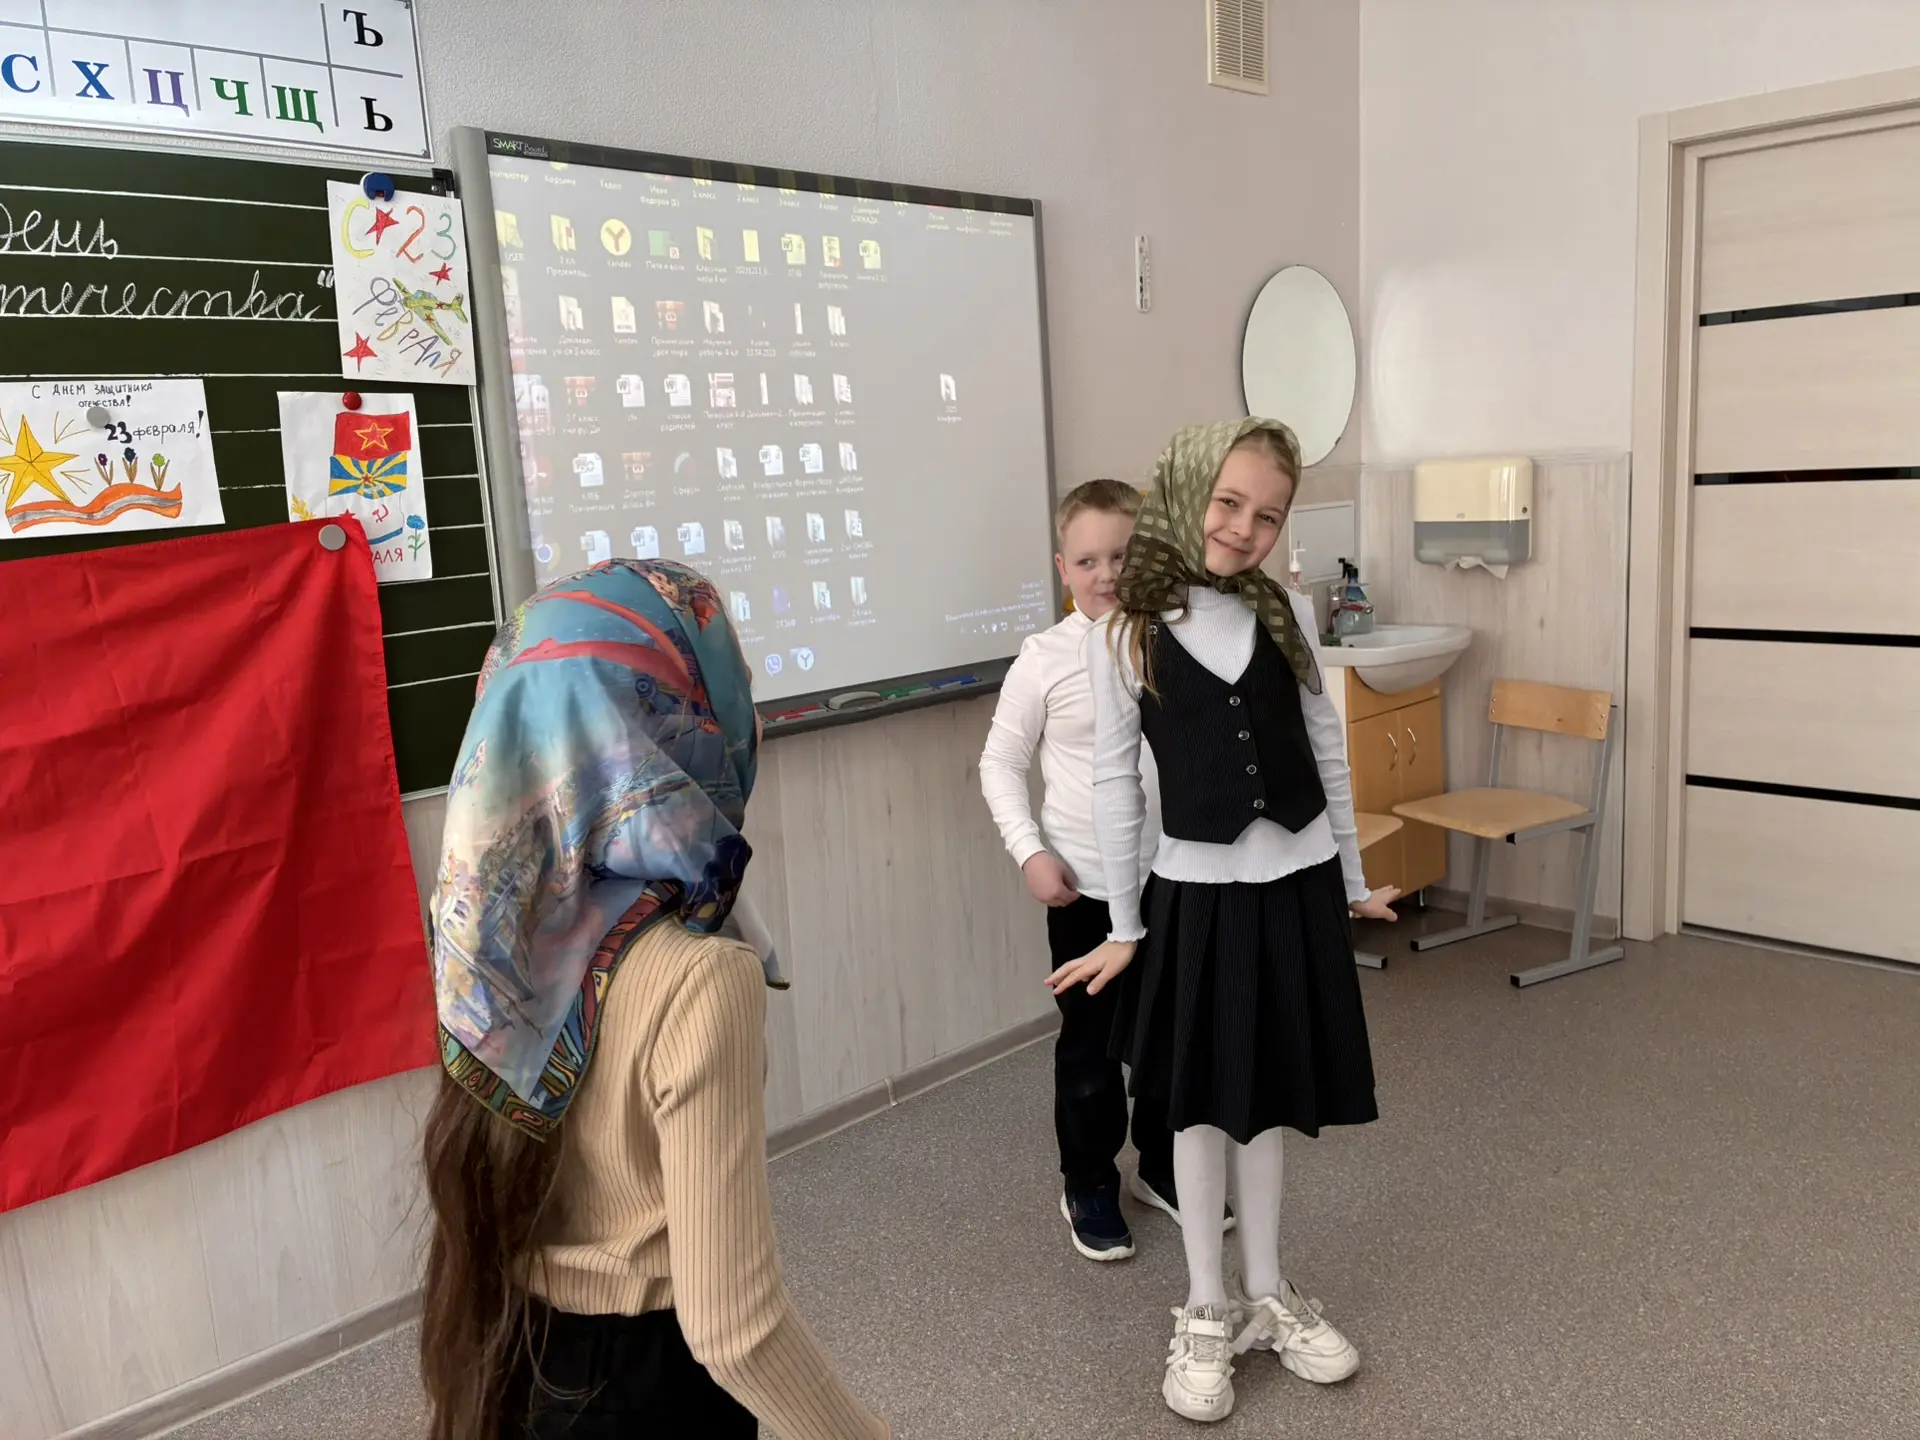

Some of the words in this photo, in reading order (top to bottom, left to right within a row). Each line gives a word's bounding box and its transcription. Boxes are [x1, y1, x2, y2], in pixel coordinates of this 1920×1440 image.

[342, 9, 384, 48] Ъ
[1, 53, 41, 94] С
[71, 60, 116, 101] Х
[142, 68, 191, 118] Ц
[209, 77, 254, 116] Ч
[271, 85, 325, 134] Щ
[360, 96, 394, 132] Ь
[493, 138, 524, 151] SMART
[341, 198, 376, 260] С
[396, 205, 457, 263] 23
[31, 384, 42, 400] С
[52, 384, 87, 396] ДНЕМ
[93, 382, 153, 397] ЗАЩИТНИКА
